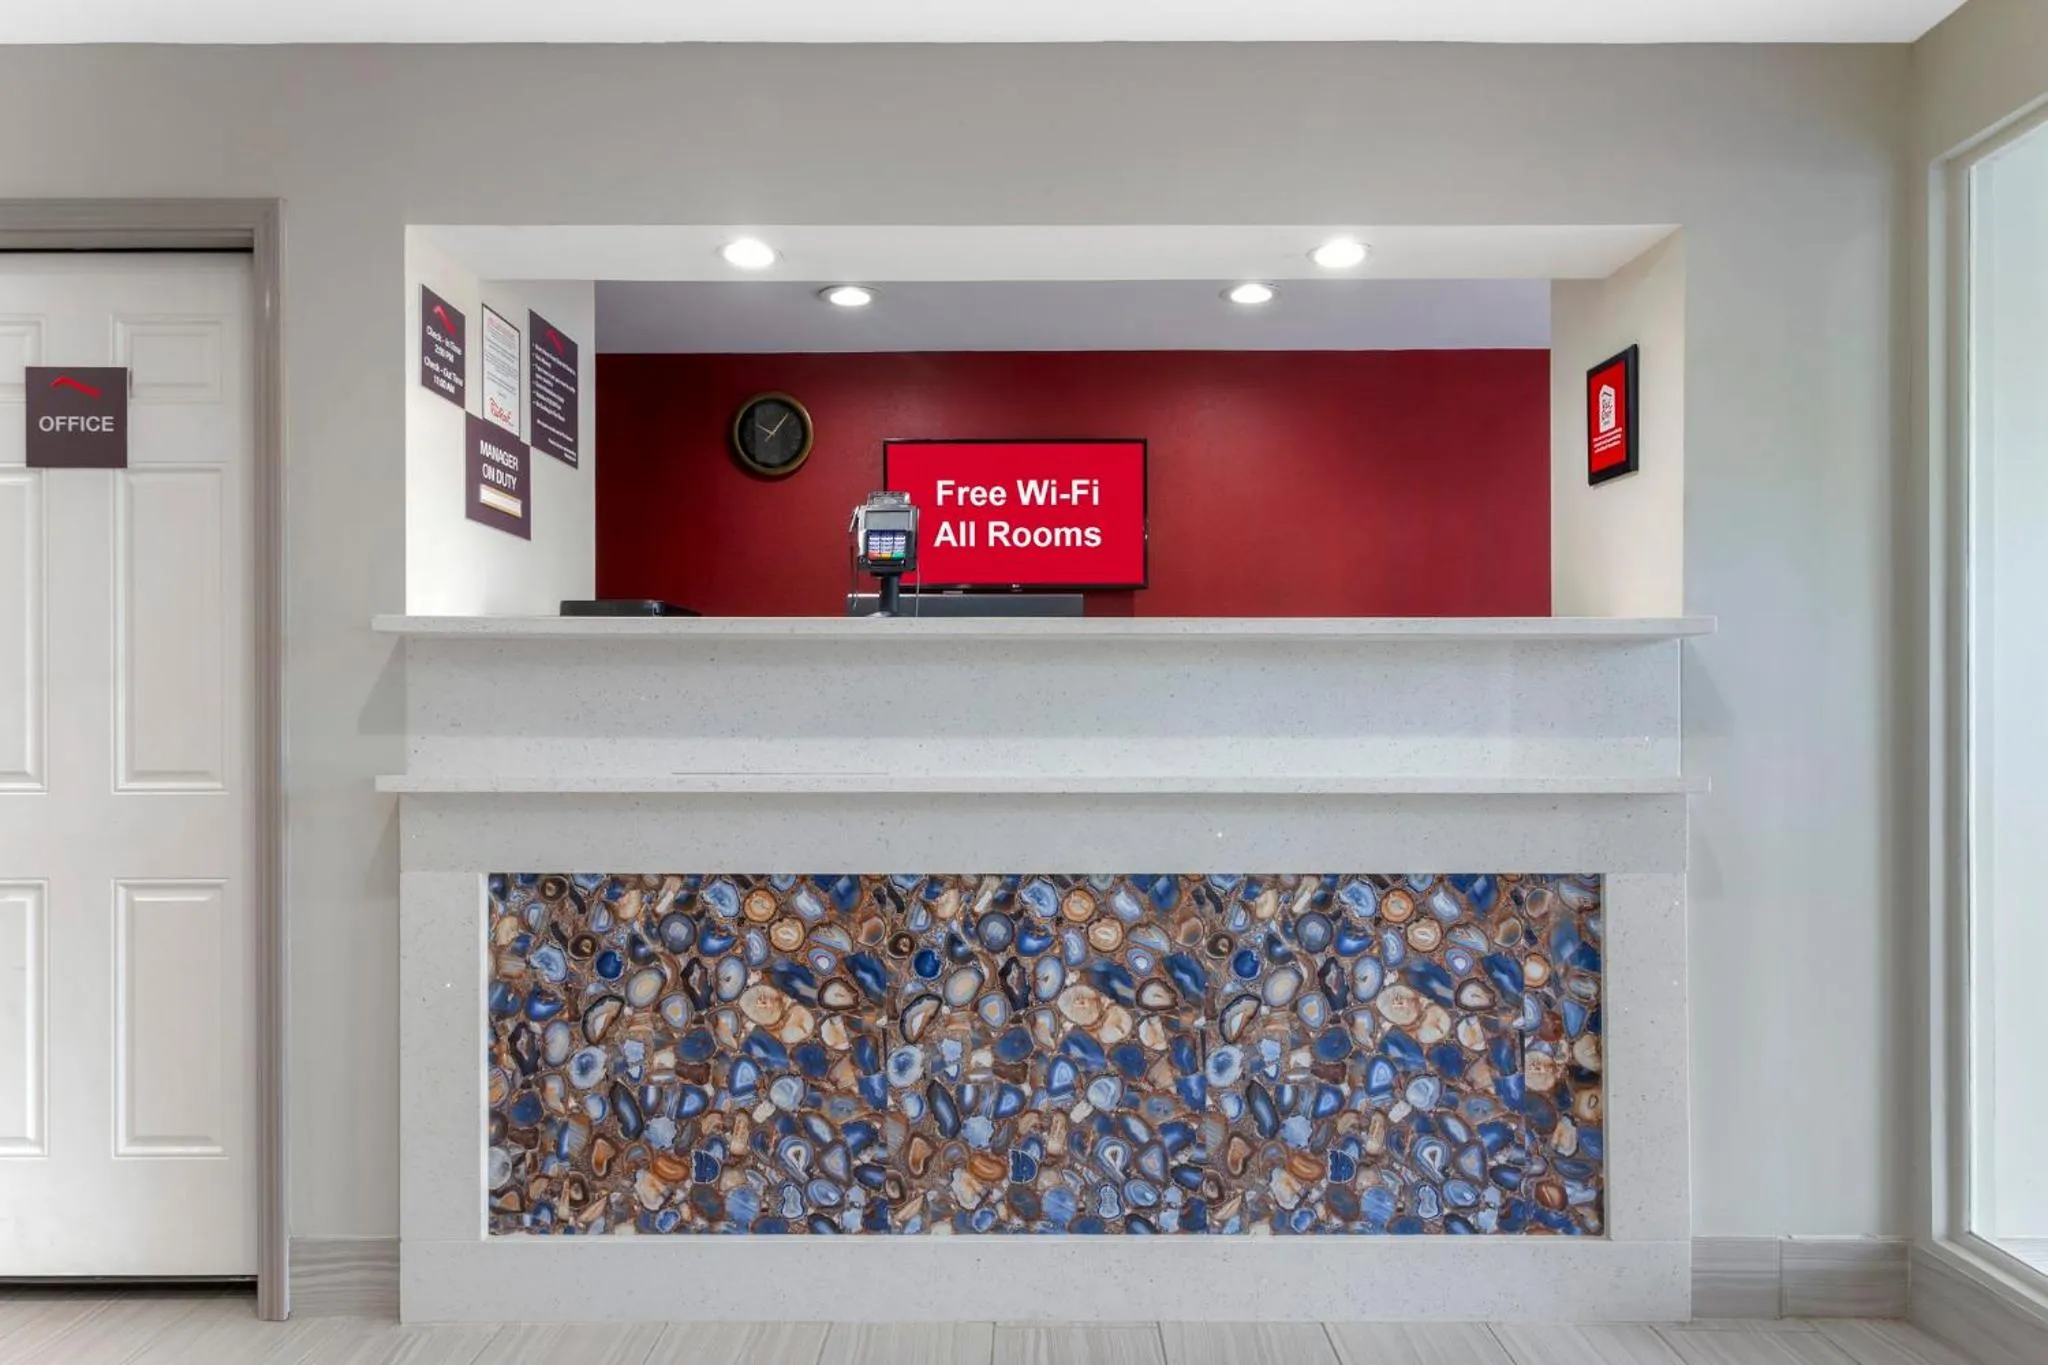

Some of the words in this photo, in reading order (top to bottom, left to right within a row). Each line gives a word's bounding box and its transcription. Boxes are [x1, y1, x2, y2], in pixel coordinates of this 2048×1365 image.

[39, 415, 115, 432] OFFICE
[480, 440, 519, 471] MANAGER
[482, 463, 495, 481] ON
[496, 469, 517, 491] DUTY
[935, 479, 1007, 506] Free
[1016, 479, 1100, 506] Wi-Fi
[933, 520, 976, 547] All
[988, 521, 1102, 547] Rooms
